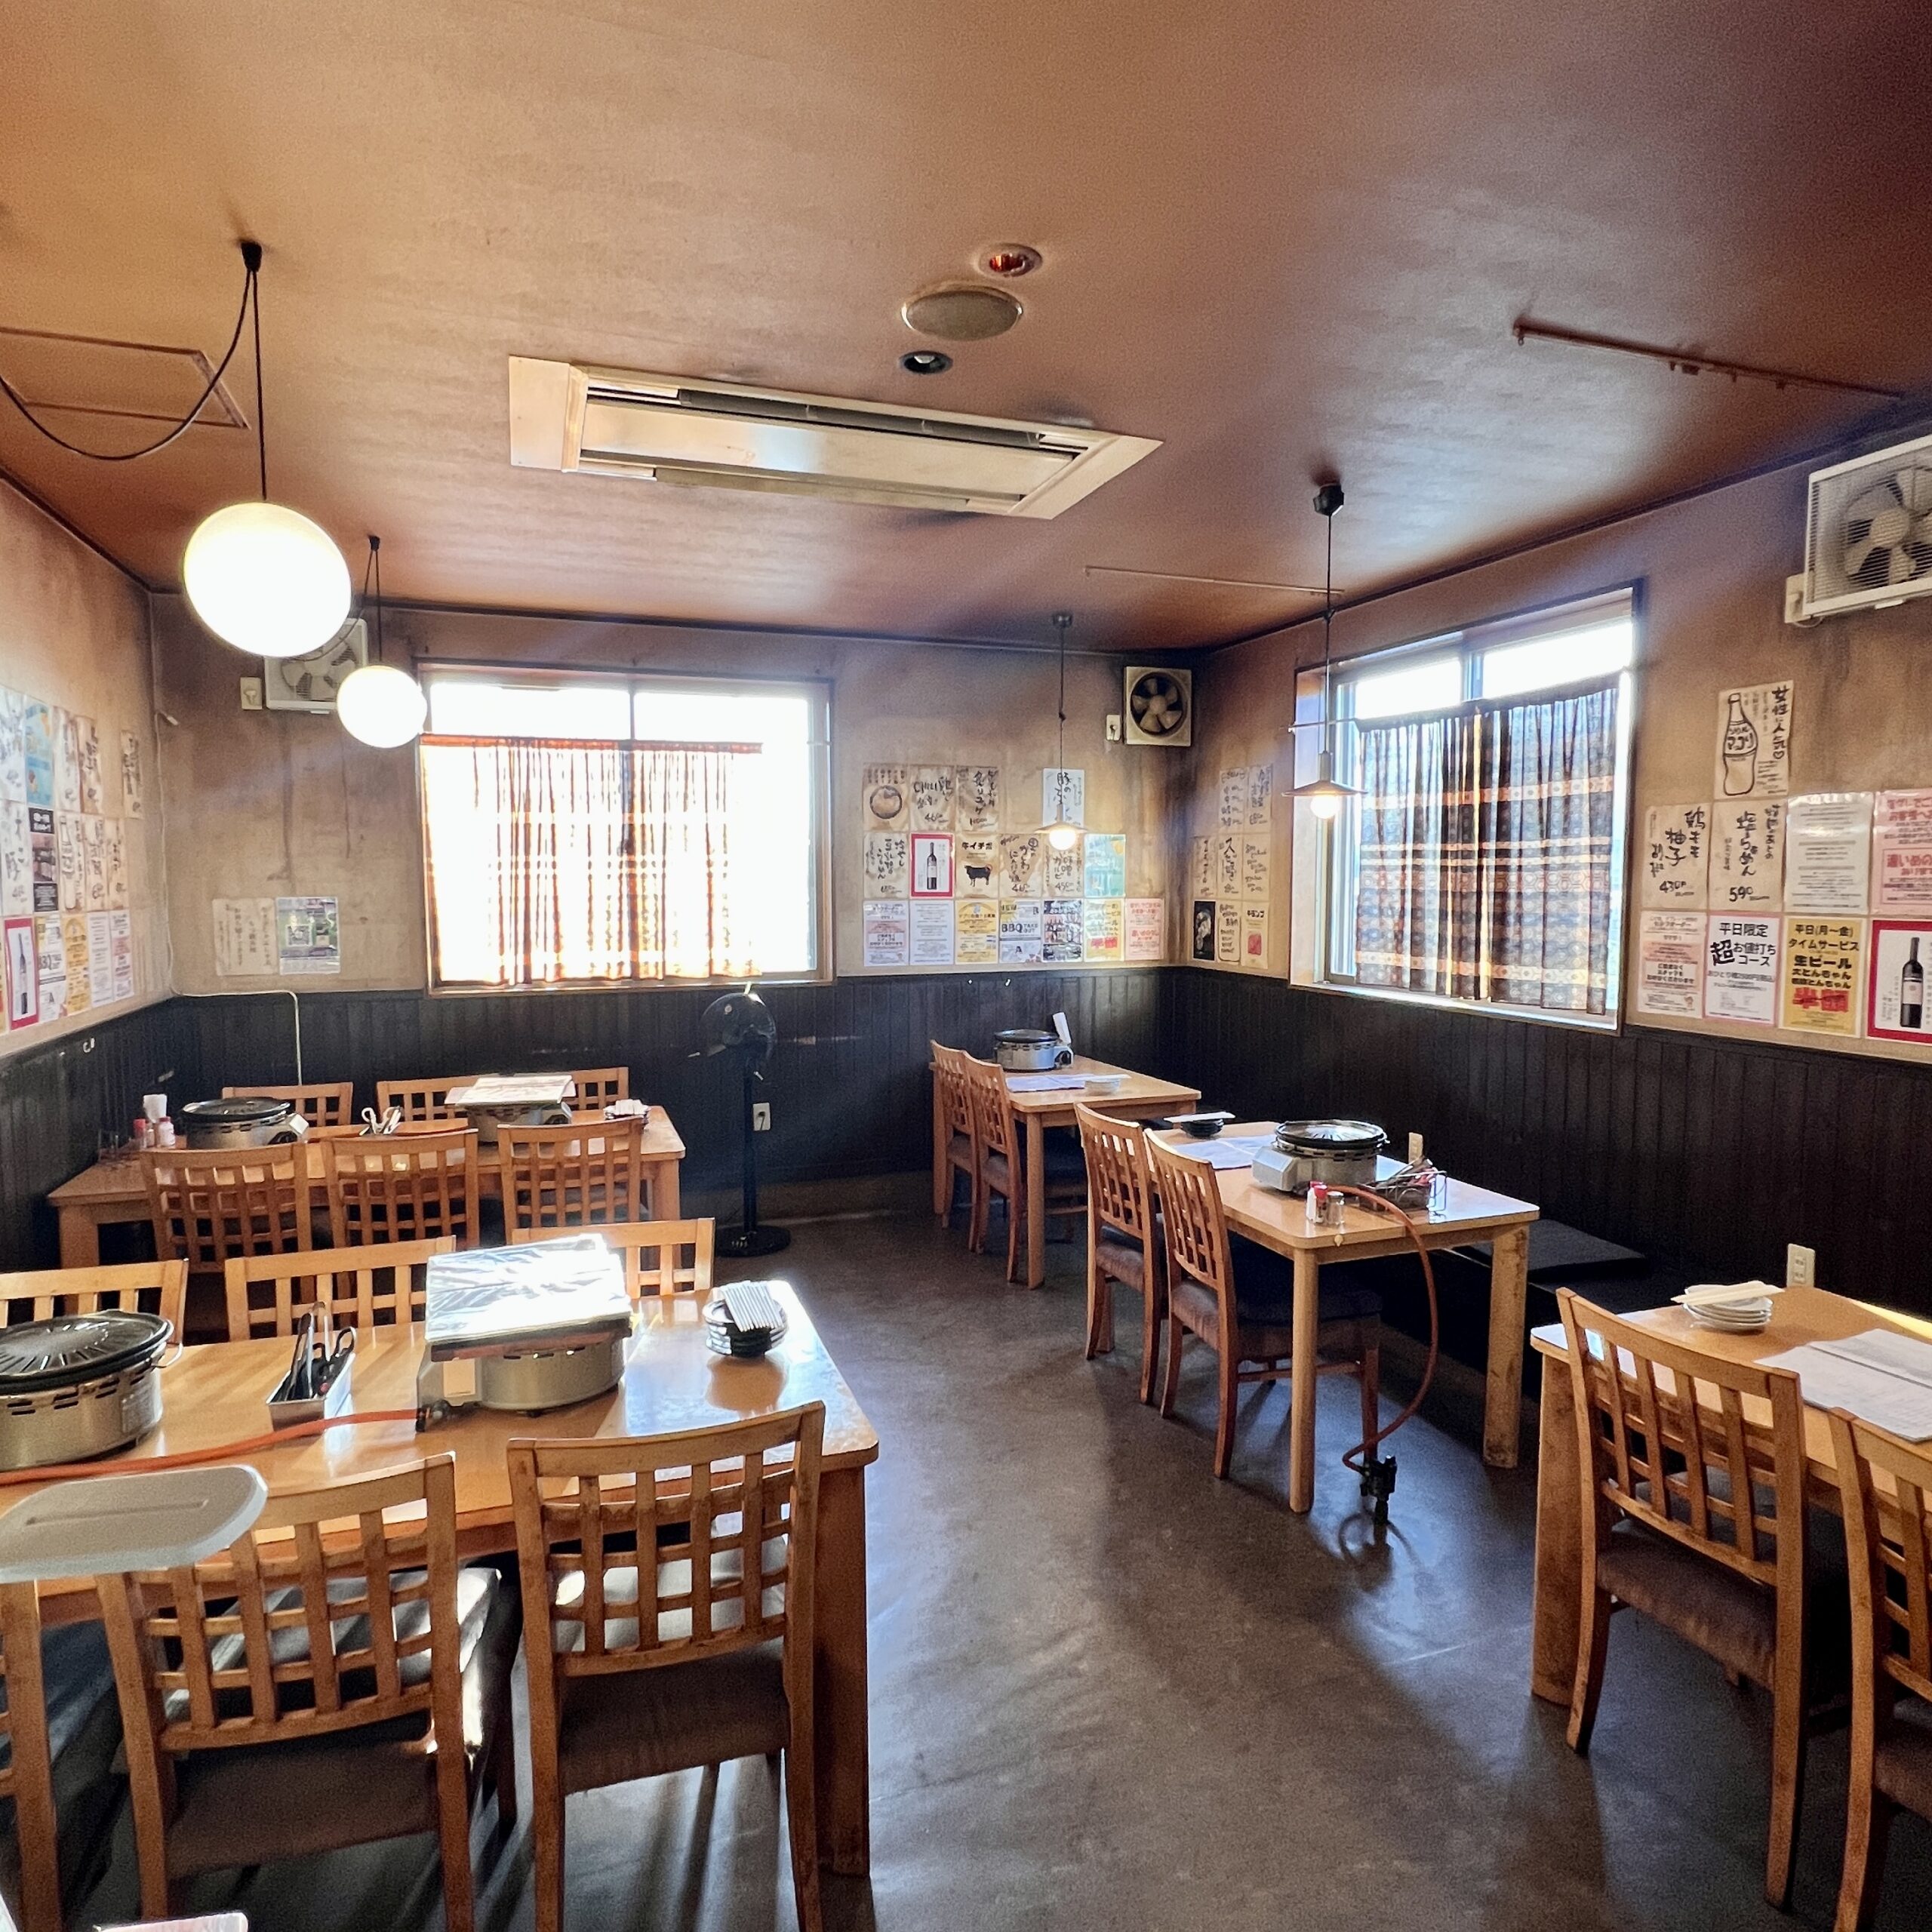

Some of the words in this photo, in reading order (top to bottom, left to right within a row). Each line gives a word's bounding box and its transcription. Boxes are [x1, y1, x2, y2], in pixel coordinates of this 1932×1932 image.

[1001, 923, 1023, 934] BBQ
[1719, 922, 1768, 937] 平日限定
[1734, 941, 1776, 955] お値打ち
[1789, 938, 1860, 951] タイムサービス
[1710, 939, 1735, 966] 超
[1738, 955, 1770, 967] コース
[1793, 954, 1852, 969] 生ビール
[1792, 986, 1850, 1013] 半額
